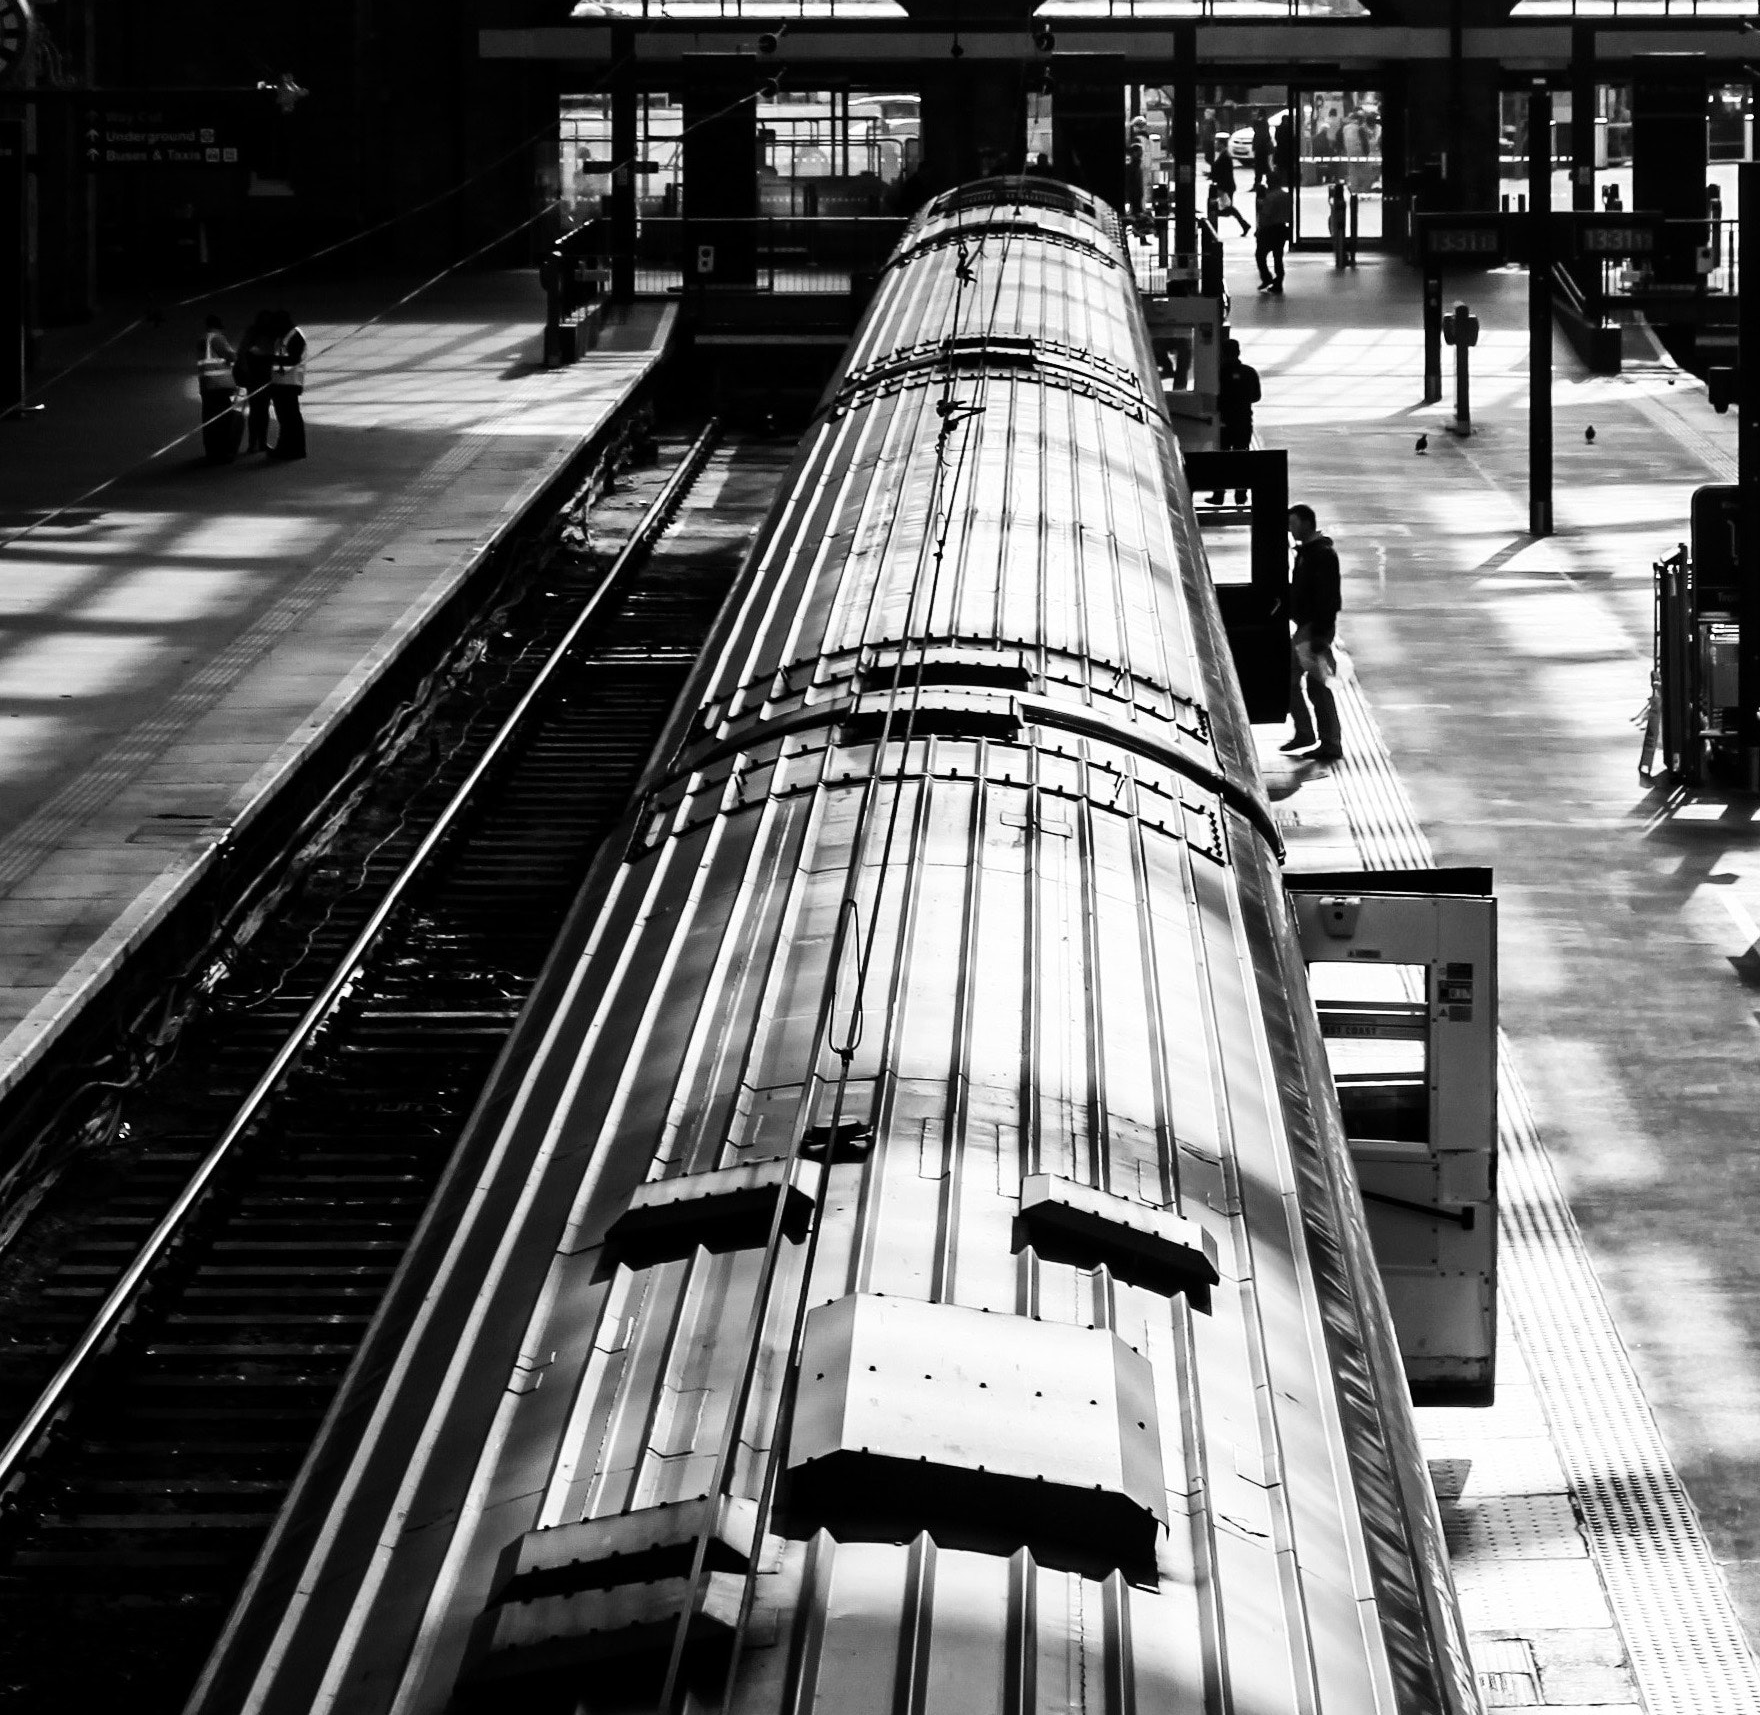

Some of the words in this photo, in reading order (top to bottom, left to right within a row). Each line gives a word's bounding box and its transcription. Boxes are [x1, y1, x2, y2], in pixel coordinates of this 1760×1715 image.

[105, 130, 196, 145] Underground
[105, 149, 147, 162] Buses
[151, 149, 163, 162] &
[167, 149, 202, 162] Taxis
[1345, 1026, 1376, 1036] COAST
